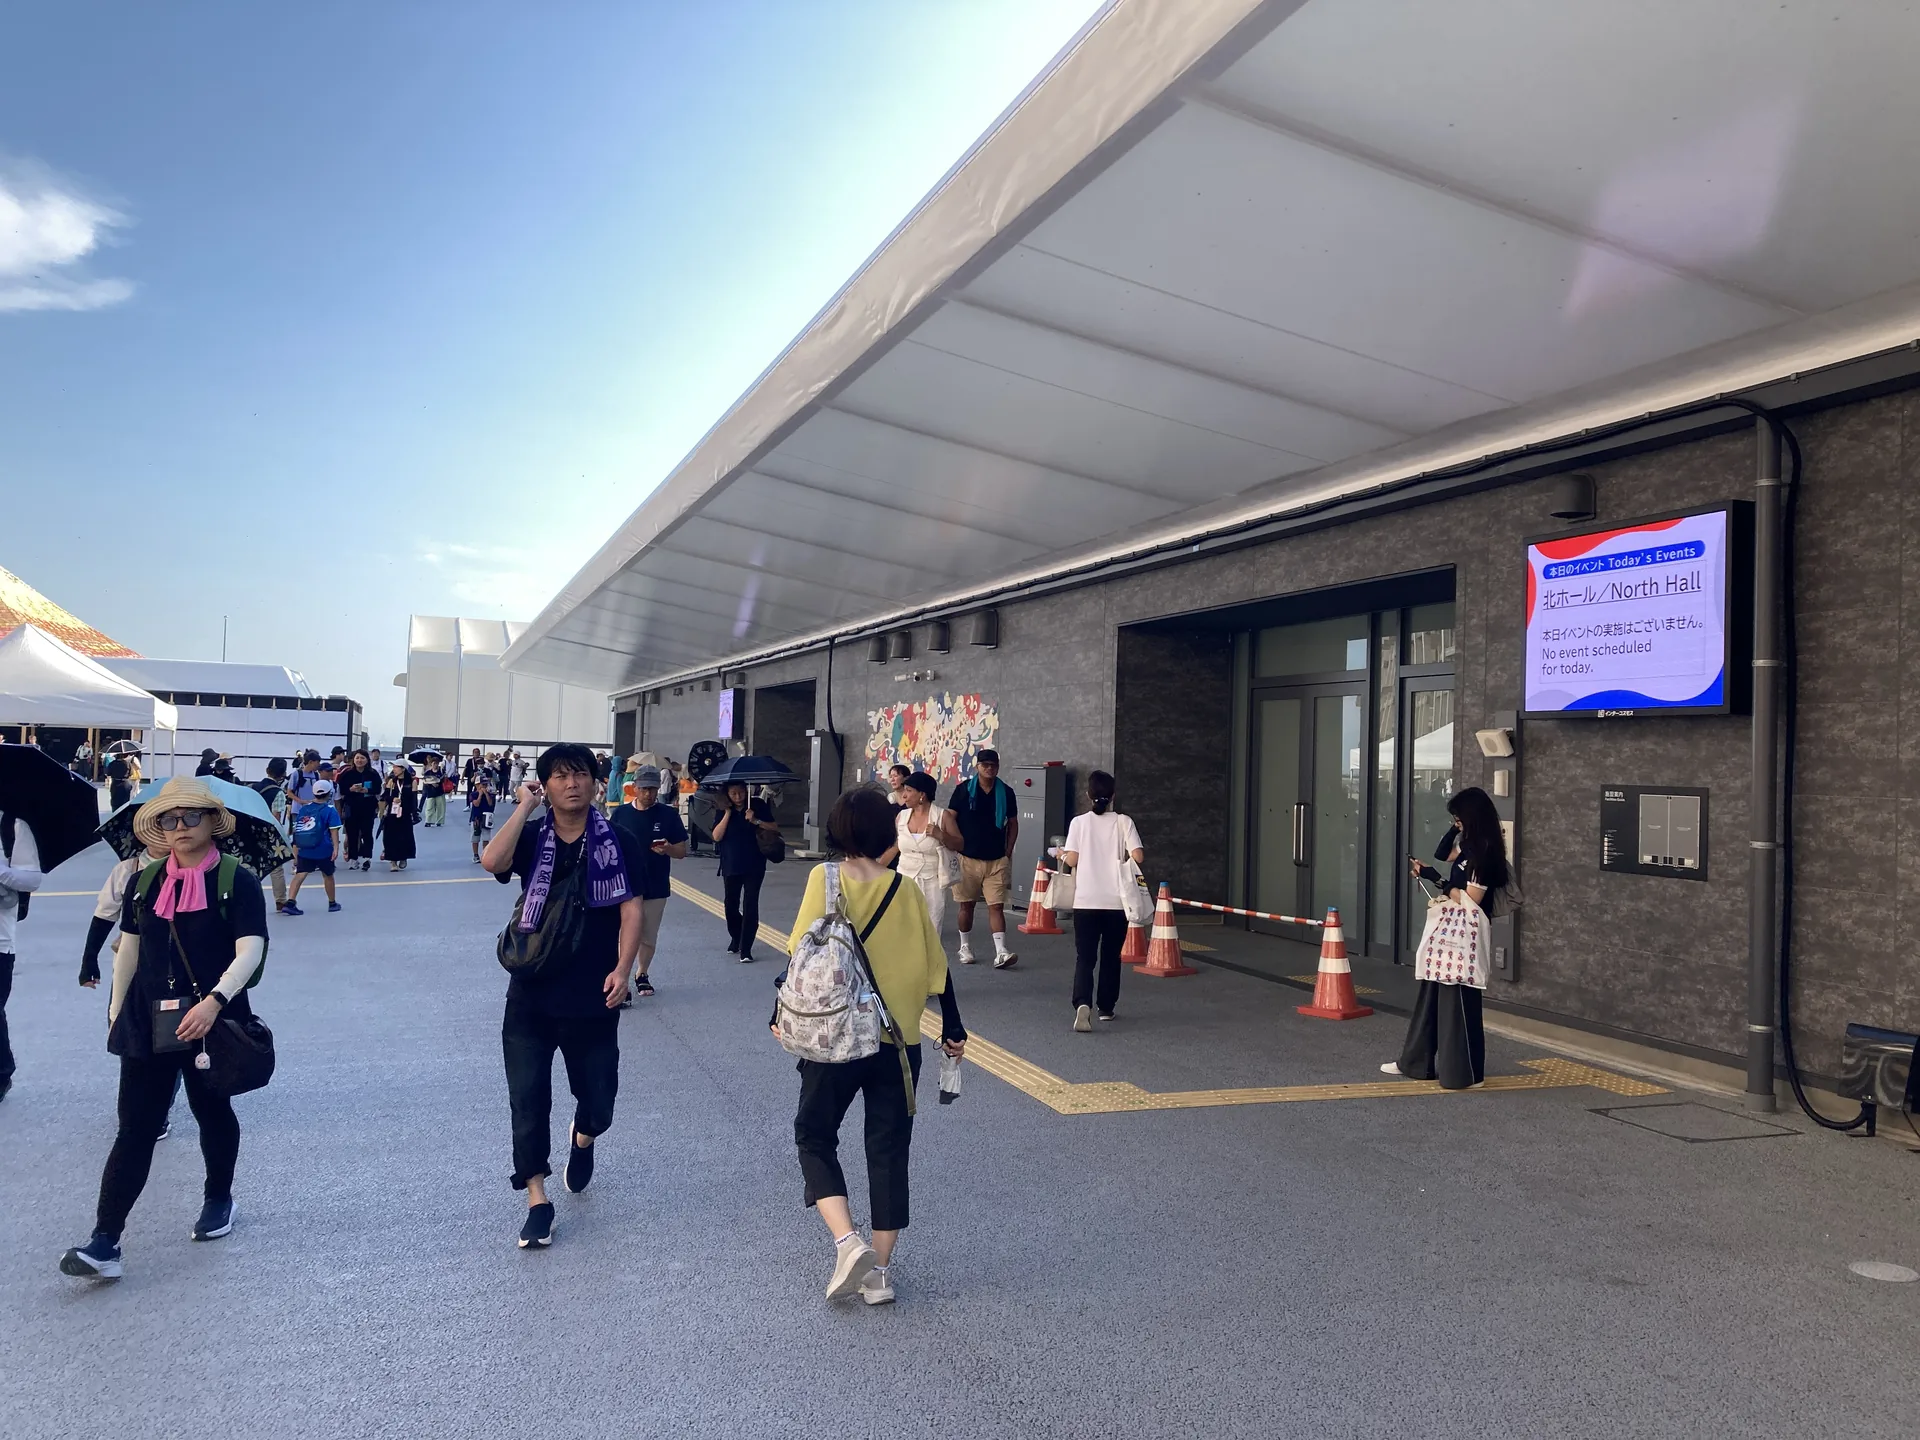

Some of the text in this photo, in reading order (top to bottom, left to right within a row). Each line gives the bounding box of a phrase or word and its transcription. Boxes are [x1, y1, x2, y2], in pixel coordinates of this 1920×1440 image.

[1549, 546, 1696, 578] 本日のイベント Today's Events
[1666, 570, 1701, 594] Hall
[1542, 615, 1704, 642] 本日イベントの実施はございません。
[1542, 639, 1652, 660] No event scheduled
[1542, 660, 1594, 676] for today.
